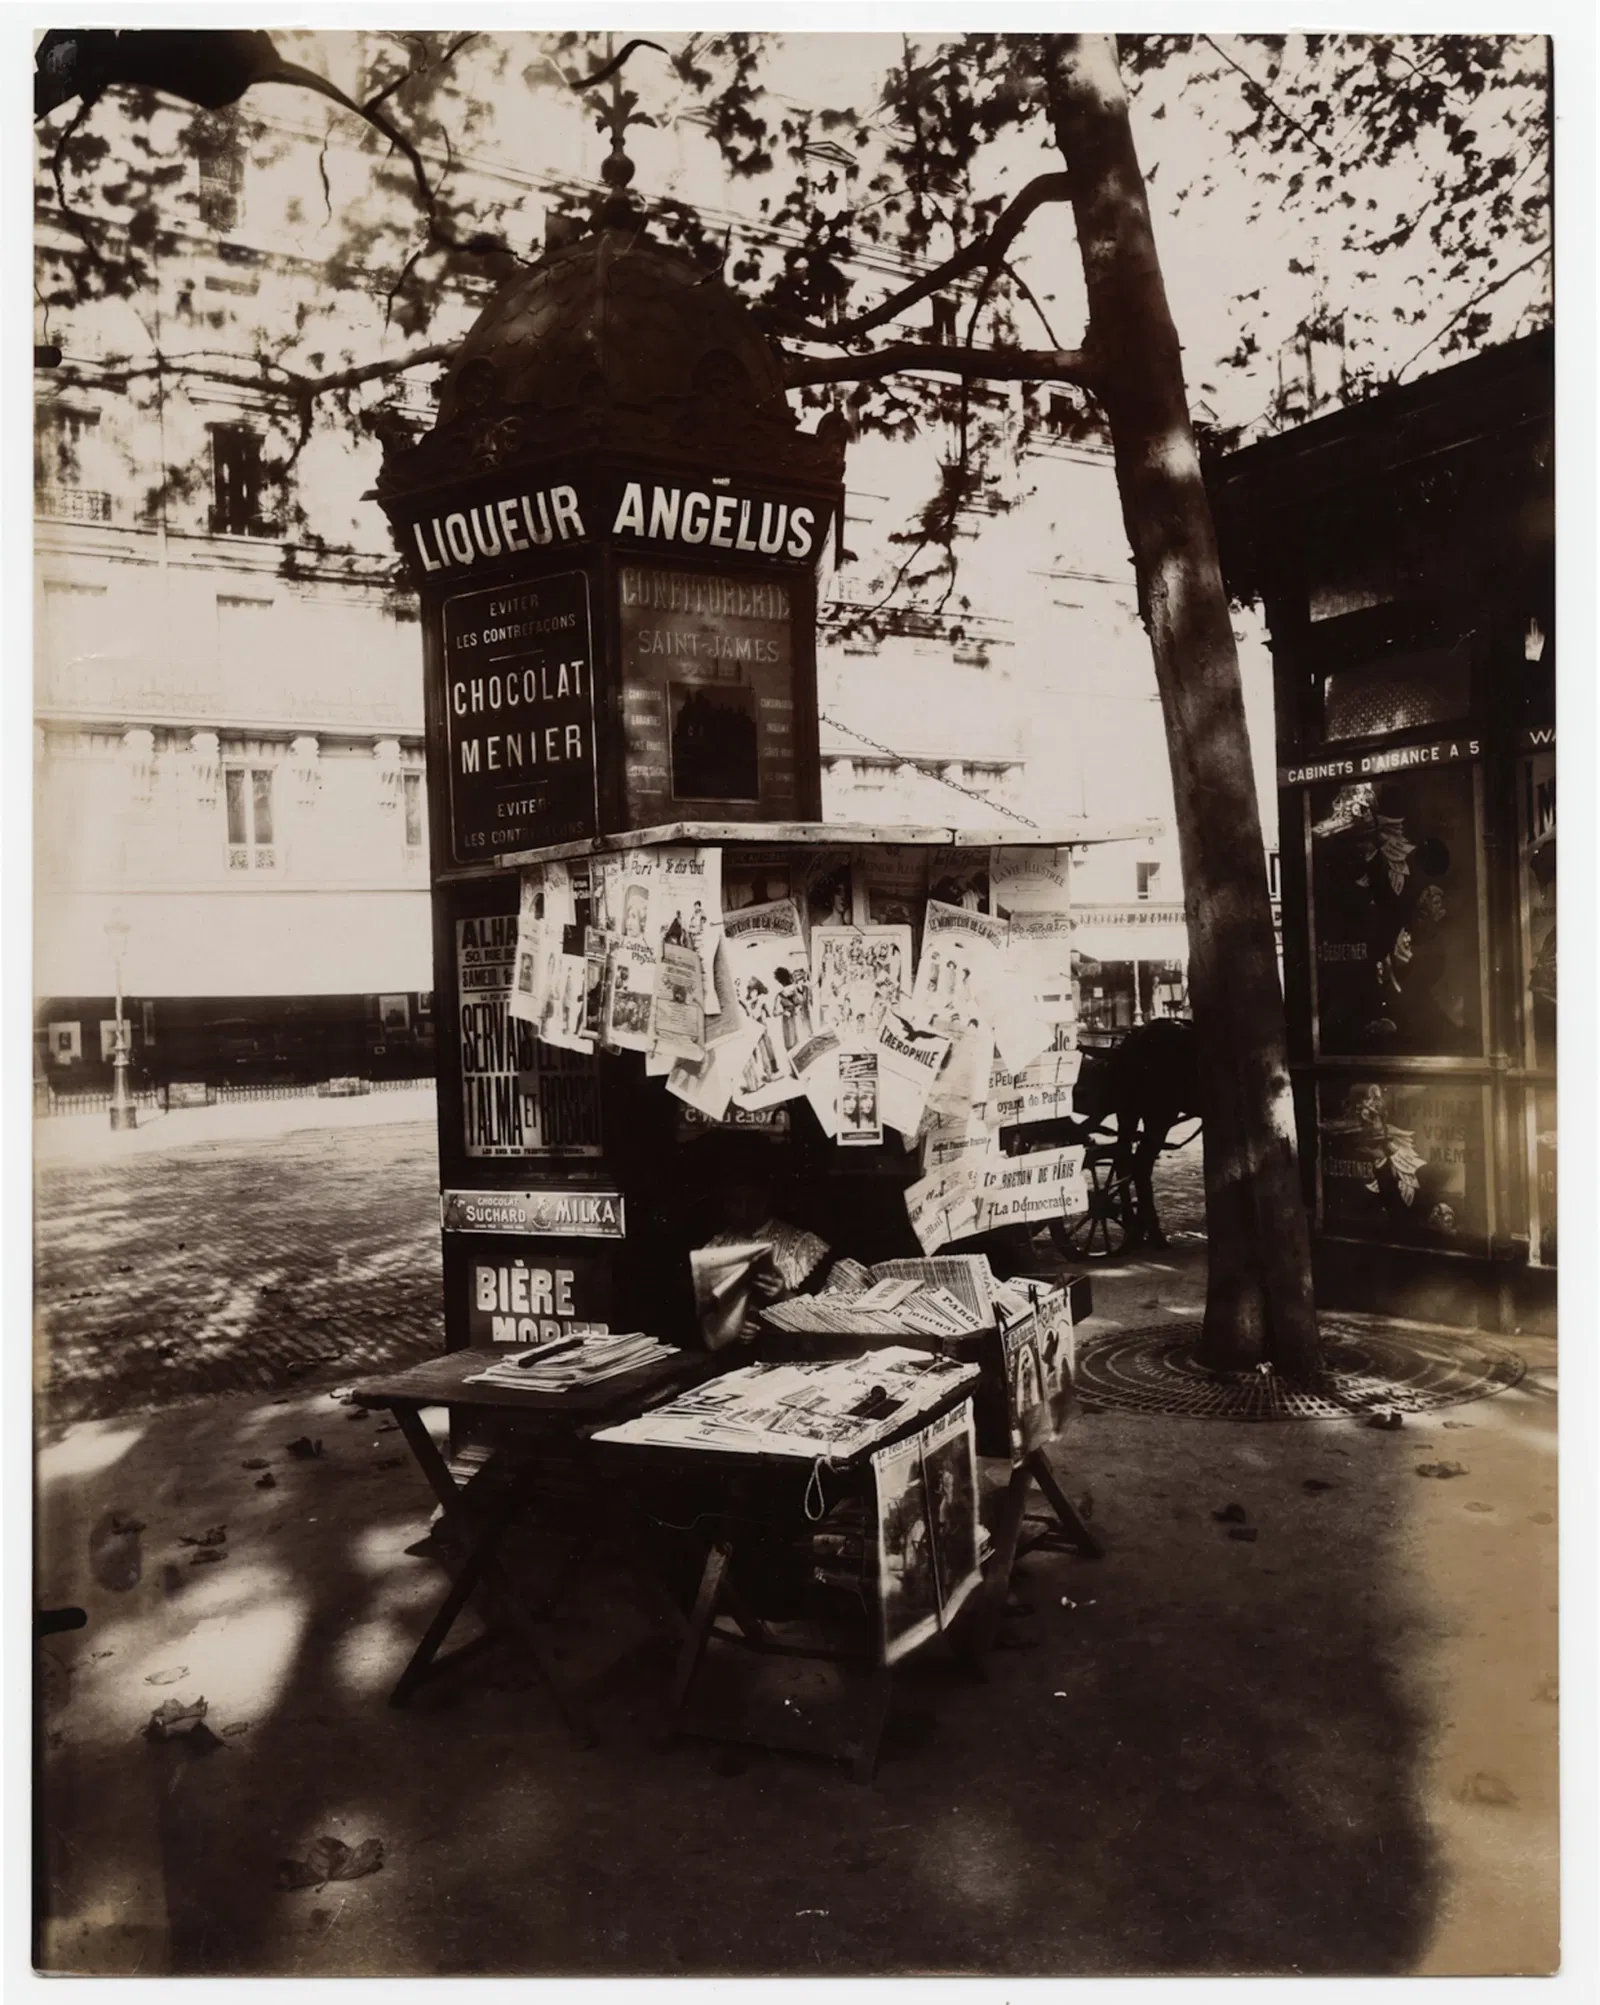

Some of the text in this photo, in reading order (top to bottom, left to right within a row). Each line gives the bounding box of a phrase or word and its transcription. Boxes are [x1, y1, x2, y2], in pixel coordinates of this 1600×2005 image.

[413, 484, 586, 572] LIQUEUR
[489, 593, 540, 618] EVITER
[456, 612, 577, 650] LES CONTREFAÇONS
[453, 660, 585, 718] CHOCOLAT
[460, 724, 583, 775] MENIER
[1288, 761, 1354, 783] CABINETS
[1361, 747, 1440, 773] D'AISANCE
[1450, 744, 1459, 757] A
[464, 831, 485, 849] LES
[464, 1076, 523, 1146] TALMA
[1038, 1167, 1049, 1183] DE
[1052, 1161, 1075, 1182] PARIS
[465, 1199, 616, 1223] SUCHARD MILKA
[476, 1259, 575, 1316] BIÈRE
